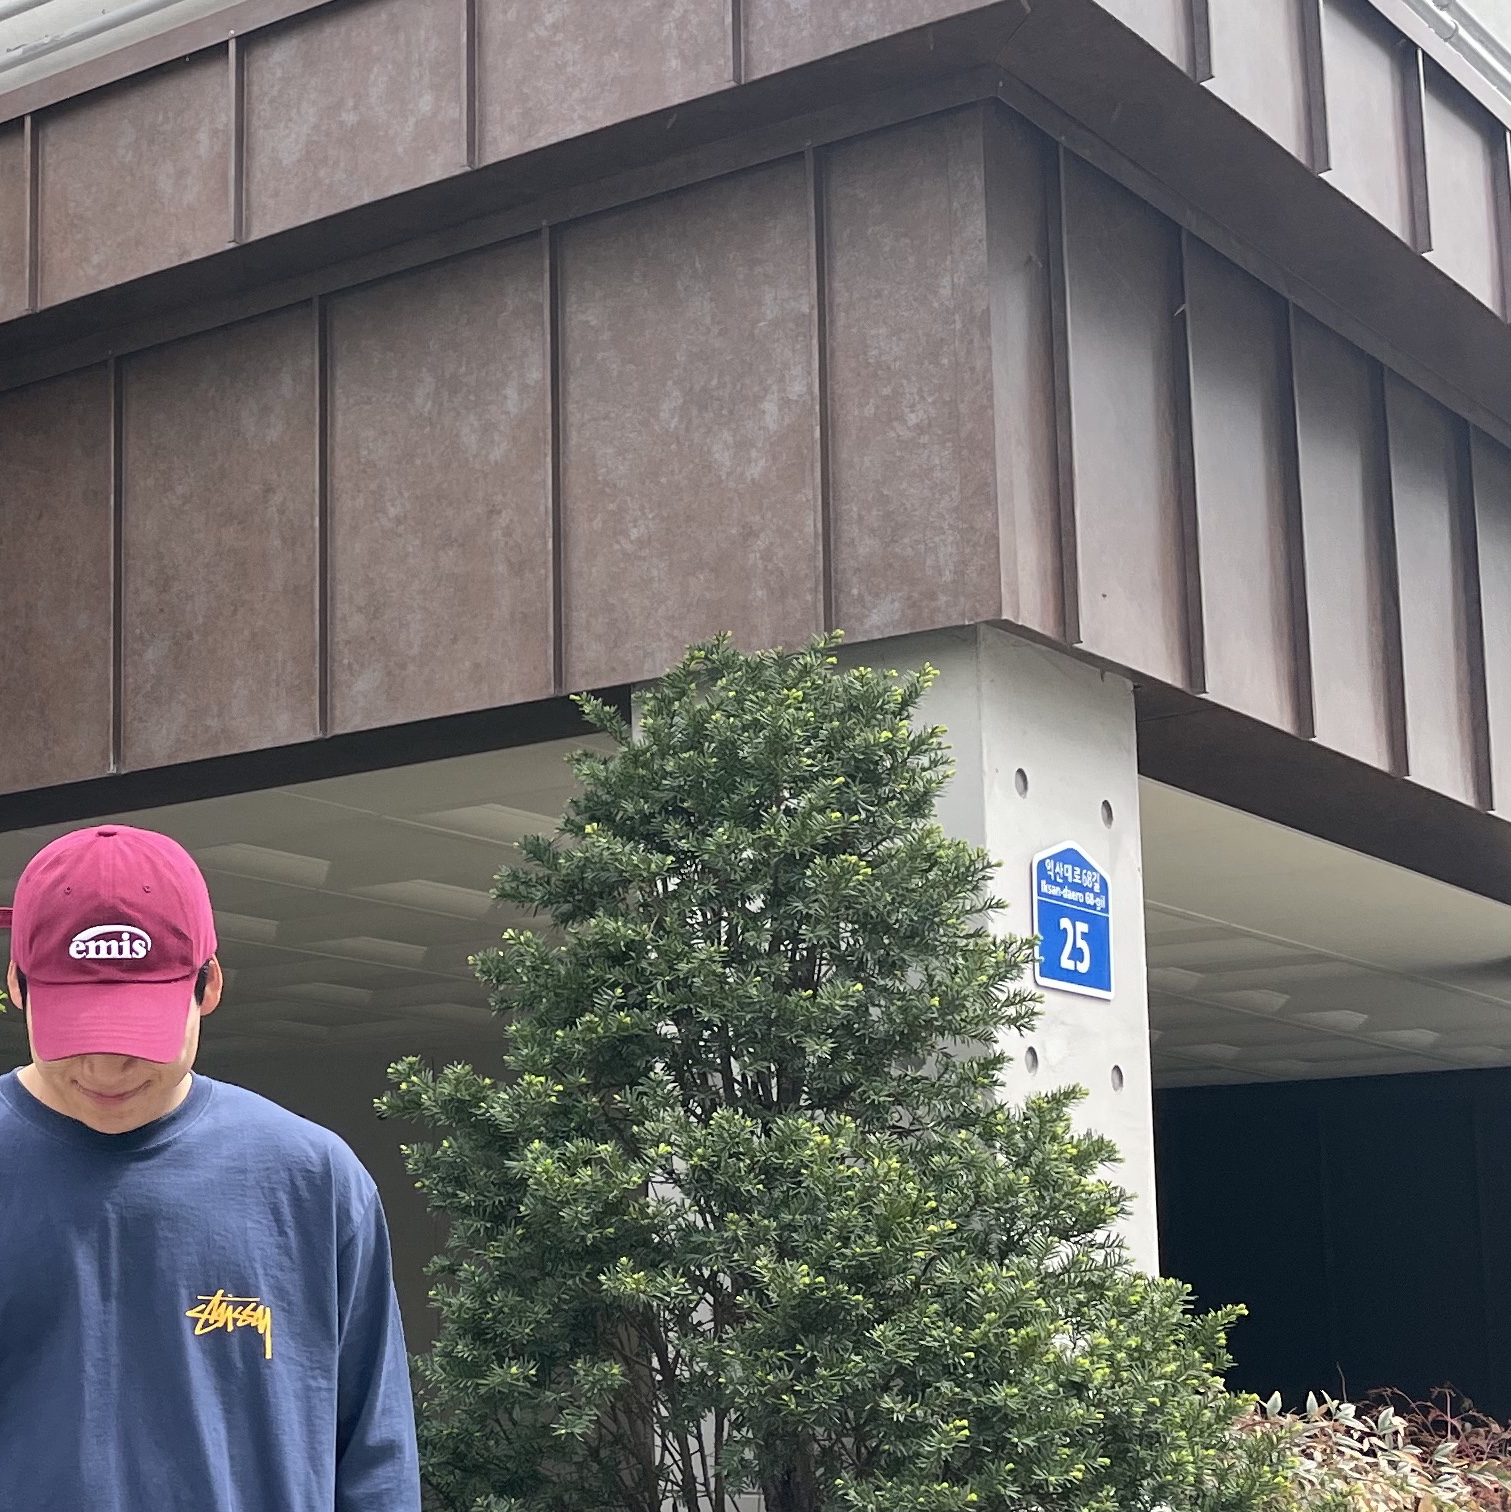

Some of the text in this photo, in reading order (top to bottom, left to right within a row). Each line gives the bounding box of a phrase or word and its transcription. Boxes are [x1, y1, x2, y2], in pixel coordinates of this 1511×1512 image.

[1040, 879, 1085, 903] Iksan-daero
[1044, 858, 1101, 893] 익산대로68길
[68, 930, 149, 960] emis
[1059, 917, 1091, 974] 25
